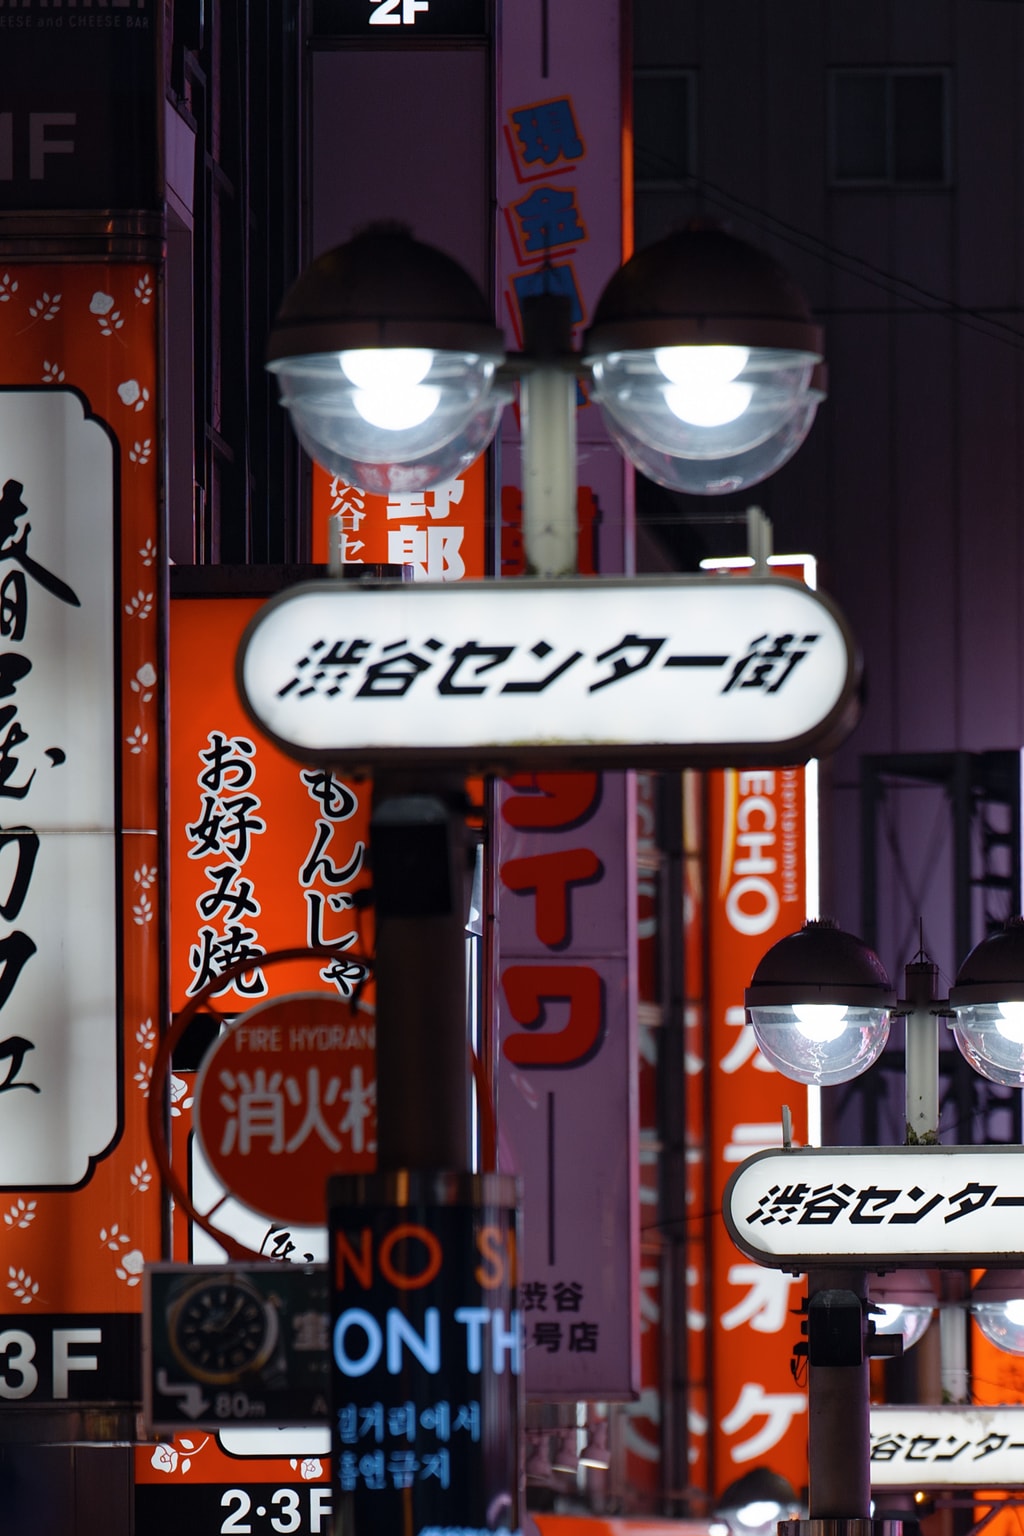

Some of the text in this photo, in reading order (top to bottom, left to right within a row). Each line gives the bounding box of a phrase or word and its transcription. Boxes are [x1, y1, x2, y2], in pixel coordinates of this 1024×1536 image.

[69, 15, 121, 28] CHEESE
[126, 16, 149, 29] BAR
[277, 634, 821, 698] 渋谷センター街
[185, 730, 268, 998] お好み焼
[299, 768, 370, 998] もんじゃ
[725, 768, 780, 936] ECHO
[234, 1028, 282, 1051] FIRE
[334, 1225, 443, 1292] NO
[332, 1306, 442, 1379] ON
[524, 1321, 599, 1353] 号店
